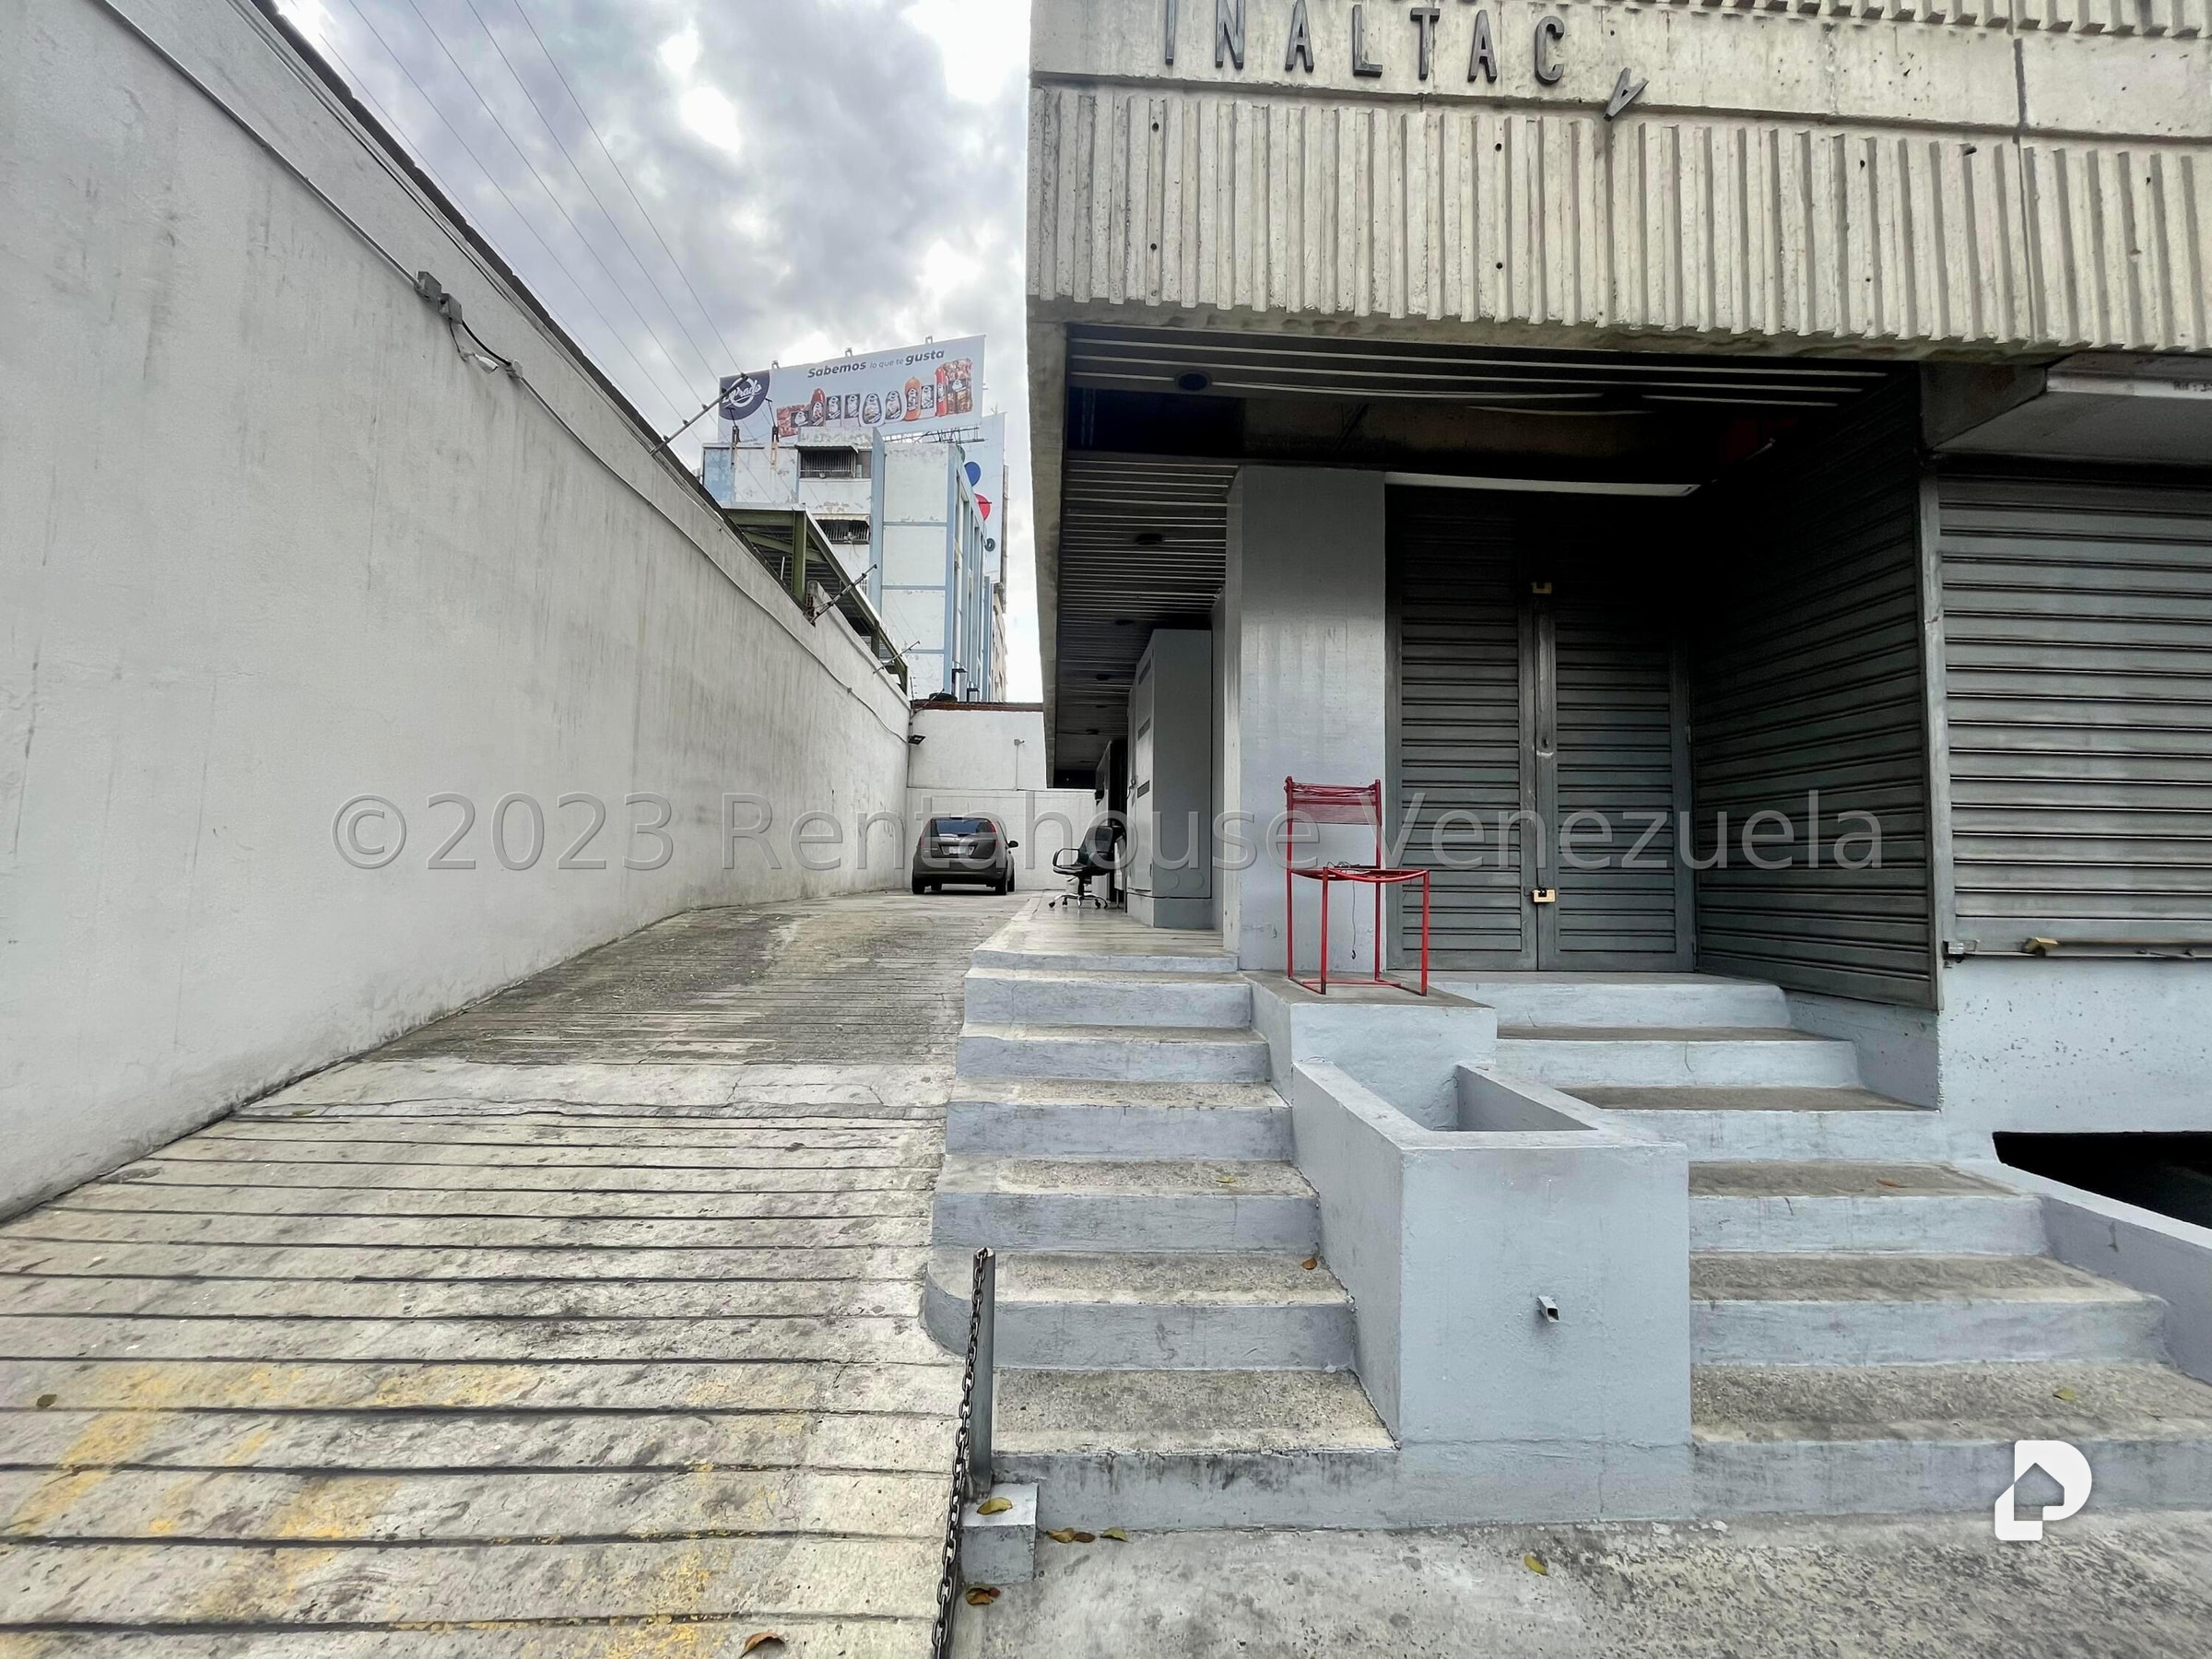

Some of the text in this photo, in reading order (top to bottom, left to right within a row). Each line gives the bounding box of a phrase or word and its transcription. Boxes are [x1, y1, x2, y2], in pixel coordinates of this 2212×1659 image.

[807, 361, 866, 379] Sabemos
[878, 359, 894, 370] que
[905, 349, 946, 366] gusta
